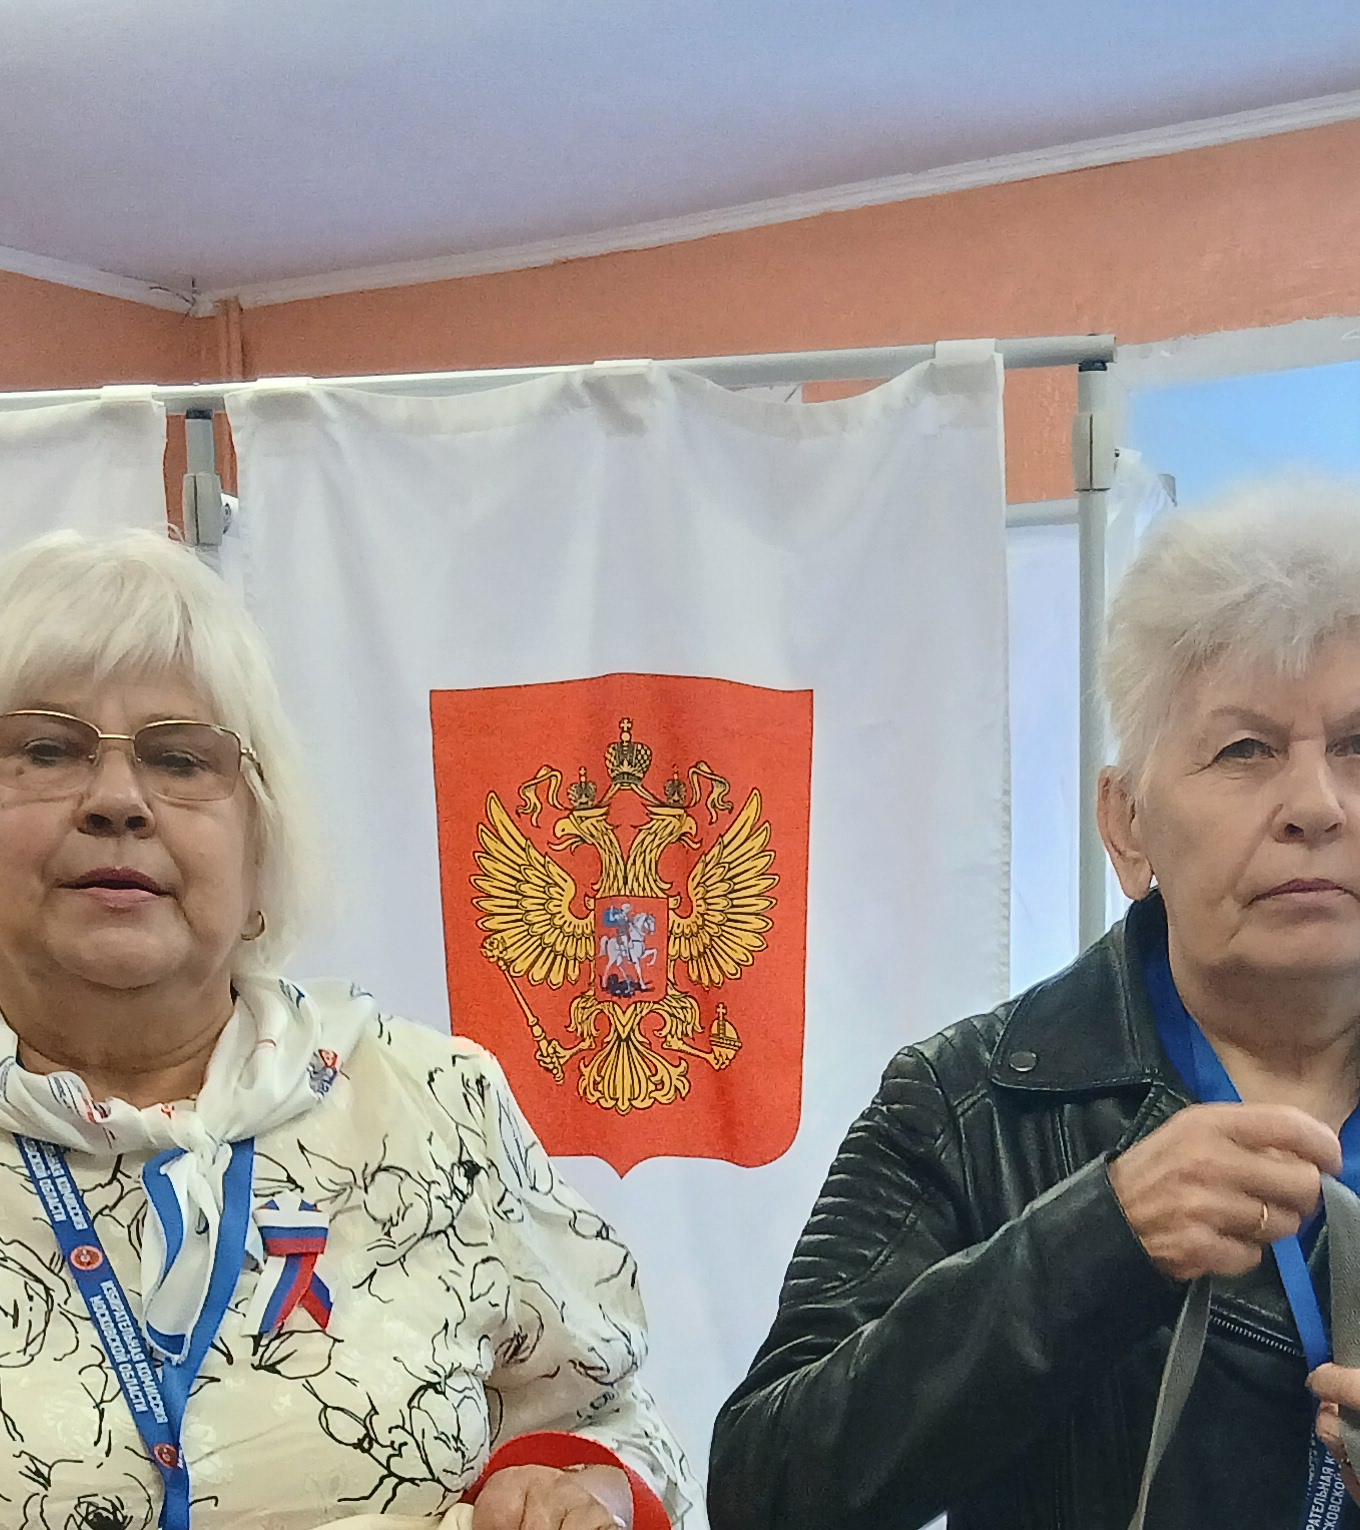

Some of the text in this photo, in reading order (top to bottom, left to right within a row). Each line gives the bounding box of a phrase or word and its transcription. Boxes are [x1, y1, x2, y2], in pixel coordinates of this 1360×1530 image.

[90, 1295, 148, 1413] МОСКОВСКОЙ ОБЛАСТИ
[100, 1280, 168, 1424] ИЗБИРАТЕЛЬНАЯ КОМИССИЯ
